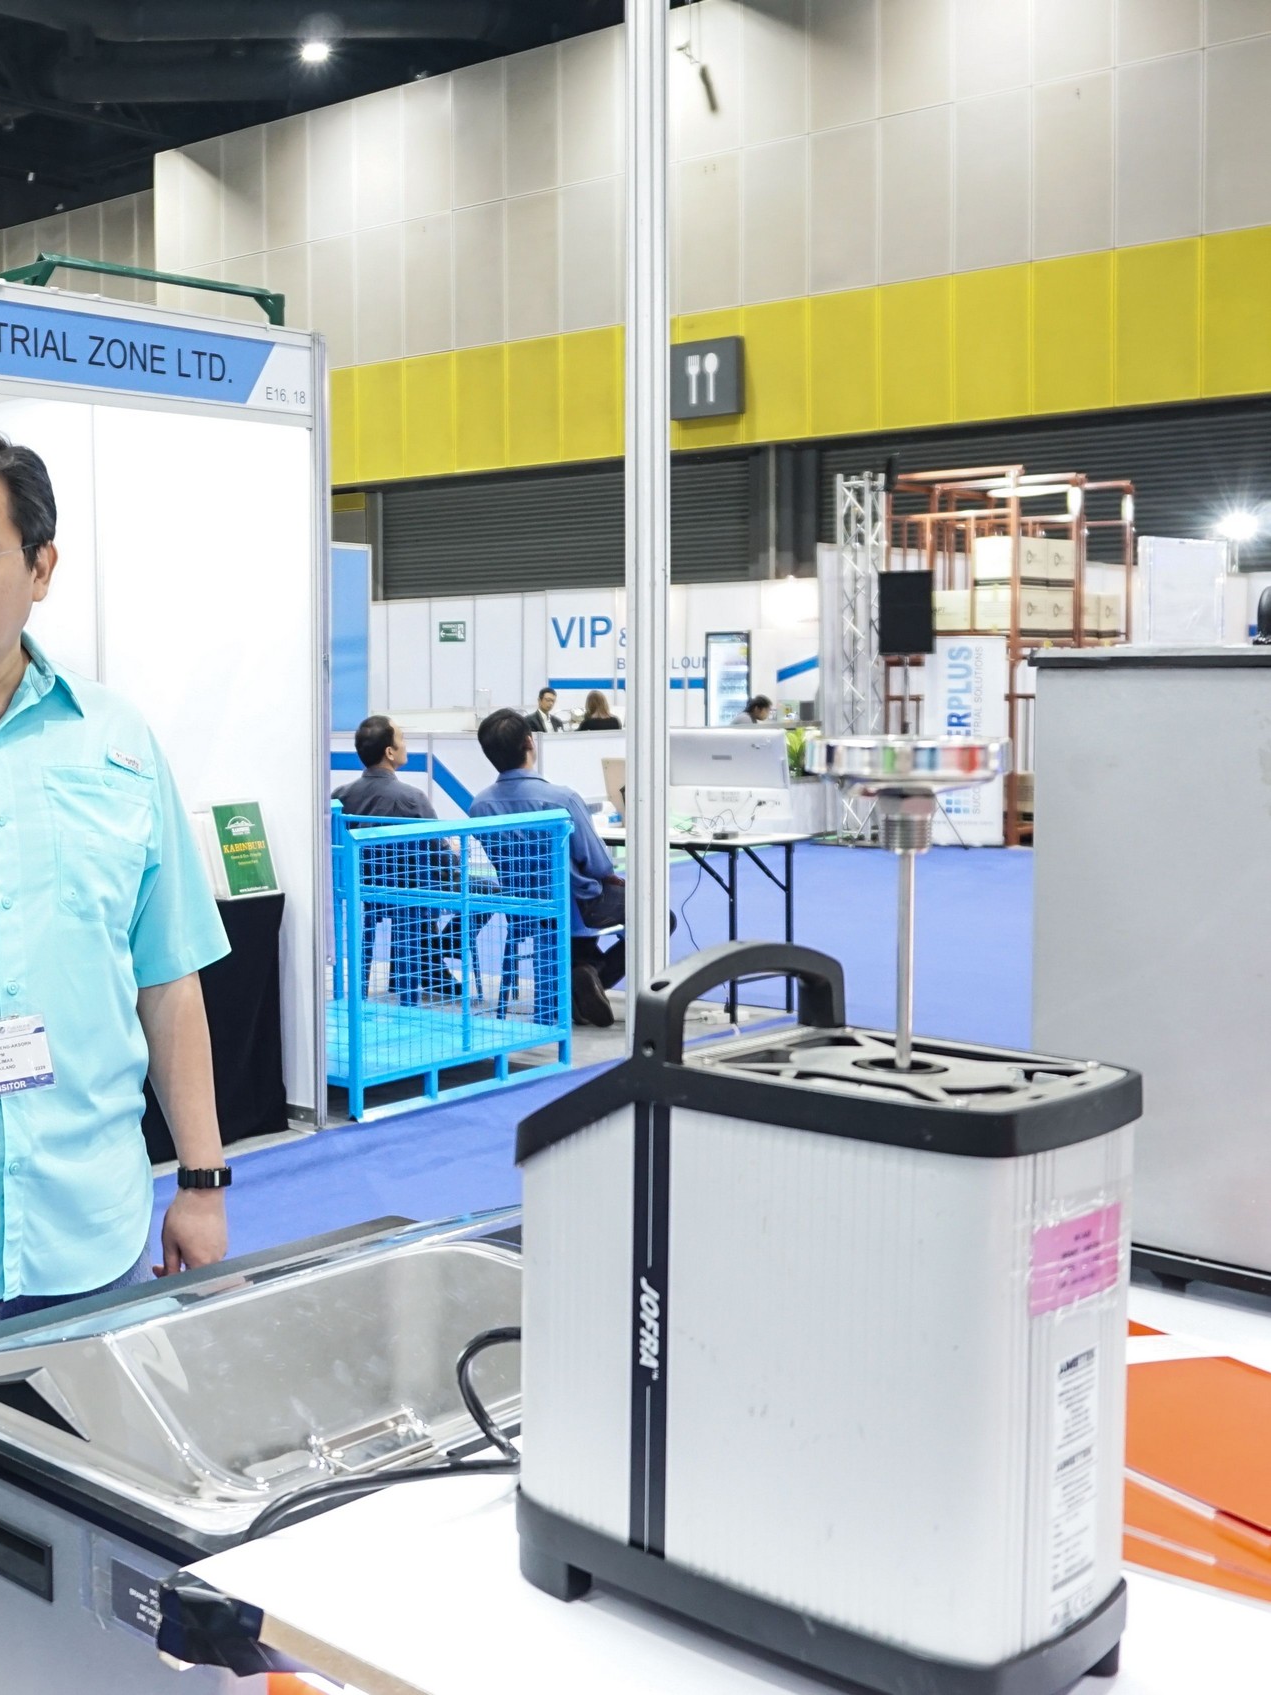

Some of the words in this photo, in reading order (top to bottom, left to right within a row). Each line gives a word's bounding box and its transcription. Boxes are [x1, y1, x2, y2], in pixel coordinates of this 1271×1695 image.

[88, 335, 167, 375] ZONE
[177, 348, 233, 384] LTD.
[293, 391, 306, 405] 18
[551, 616, 613, 649] VIP
[671, 656, 706, 669] LOU
[974, 646, 983, 703] SOLUTIONS
[222, 840, 266, 854] KABINBURI
[638, 1275, 661, 1370] JOFRA
